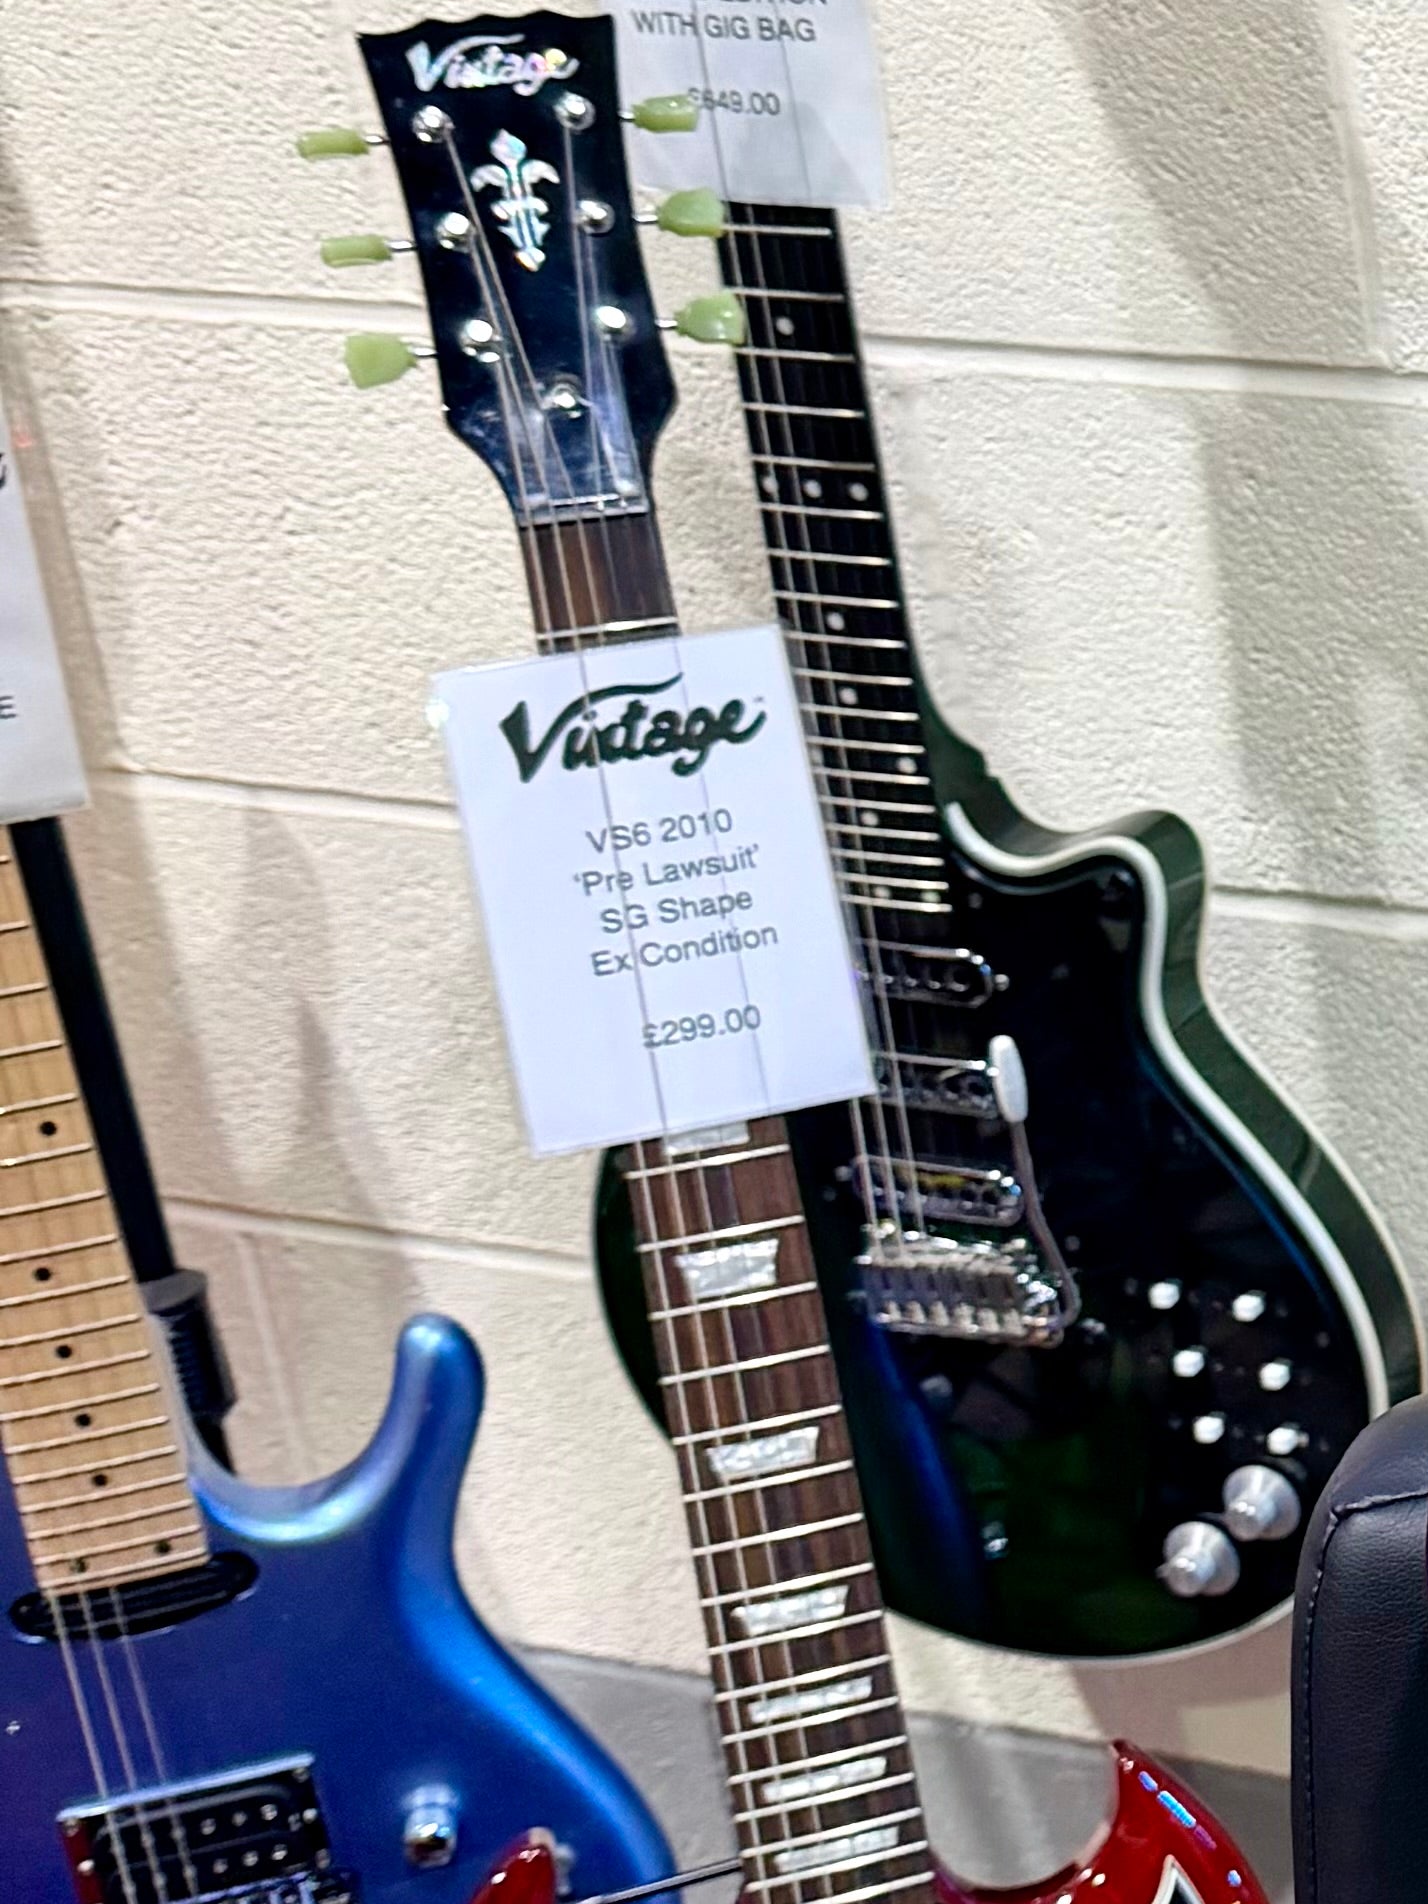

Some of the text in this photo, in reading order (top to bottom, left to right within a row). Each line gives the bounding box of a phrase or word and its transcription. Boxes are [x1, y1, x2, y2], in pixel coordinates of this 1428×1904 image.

[631, 10, 817, 43] WITH GIG BAG
[500, 671, 767, 783] Vintage
[585, 808, 733, 854] VS6 2010
[600, 891, 753, 934] SG Shape
[591, 926, 779, 977] Ex Condition
[642, 1004, 761, 1049] £299.00
